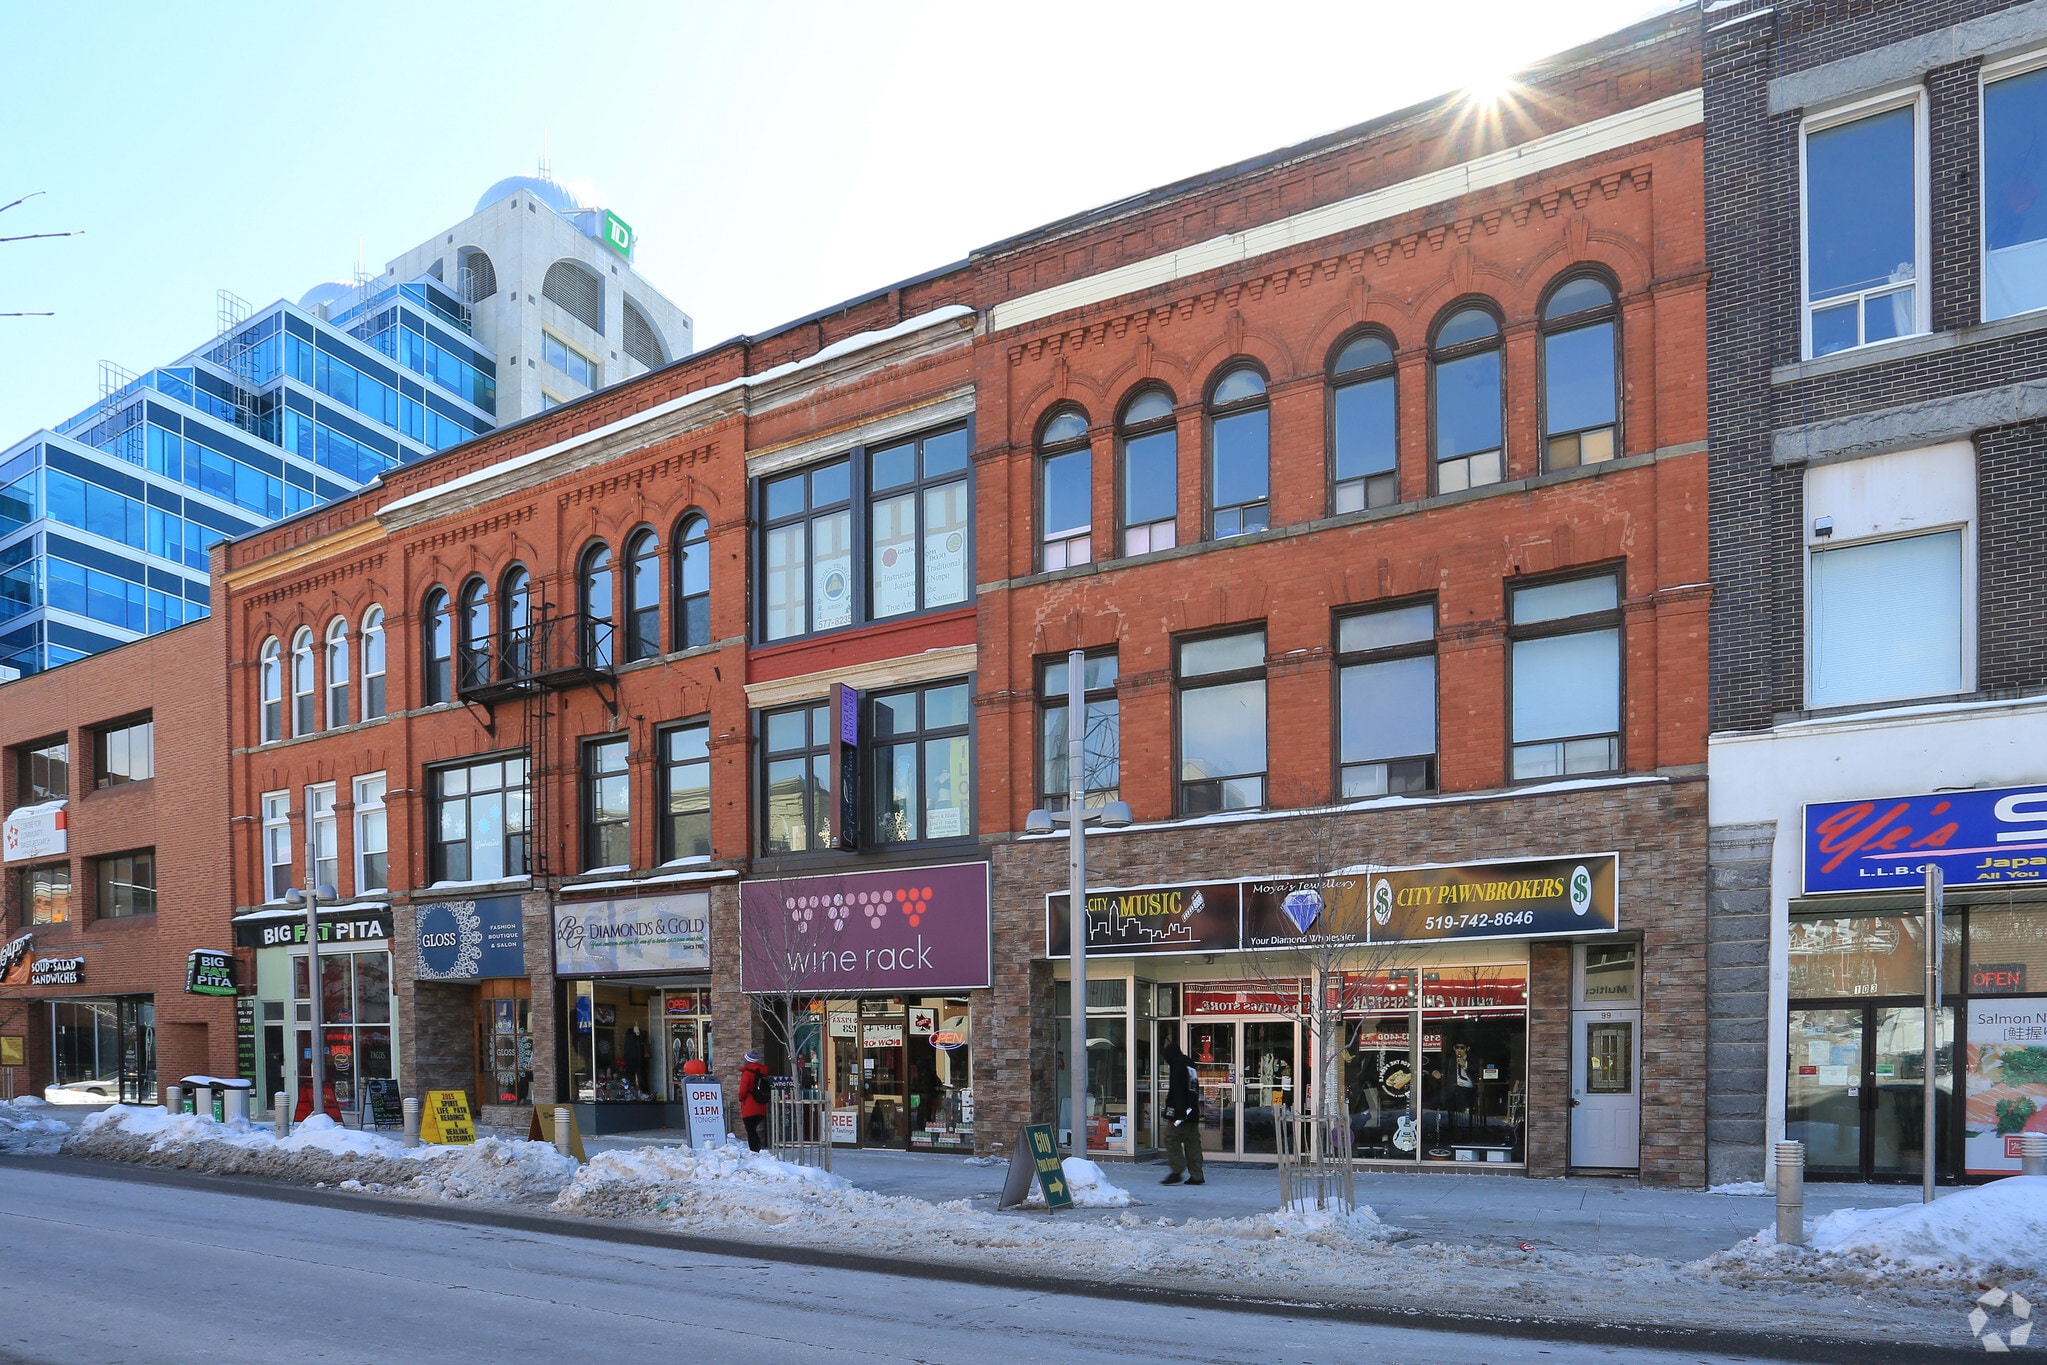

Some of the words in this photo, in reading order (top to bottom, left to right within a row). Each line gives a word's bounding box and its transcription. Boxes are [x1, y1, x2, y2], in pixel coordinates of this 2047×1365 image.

[607, 216, 629, 249] TD
[926, 558, 961, 572] Traditional
[1976, 872, 2000, 880] All
[2005, 870, 2040, 879] You
[1252, 883, 1296, 894] Moya's
[1298, 879, 1356, 892] Jewellery
[1397, 886, 1436, 907] CITY
[1437, 877, 1565, 905] PAWNBROKERS
[1087, 897, 1108, 912] CITY
[1118, 891, 1183, 917] MUSIC
[1425, 910, 1534, 931] 519-742-8646
[264, 925, 291, 945] BIG
[335, 920, 384, 940] PITA
[589, 921, 653, 939] DIAMONDS
[656, 919, 666, 935] &
[668, 917, 704, 933] GOLD
[422, 932, 456, 947] GLOSS
[488, 932, 519, 940] BOUTIQUE
[1250, 936, 1270, 945] Your
[1271, 935, 1308, 945] Diamond
[1309, 933, 1356, 944] Wholesaler
[787, 942, 857, 973] wine
[865, 934, 933, 971] rack
[201, 956, 225, 967] BIG
[200, 966, 230, 978] FAT
[31, 972, 77, 985] SANDWICHES
[197, 975, 233, 988] PITA
[1973, 971, 2020, 986] OPEN
[1854, 984, 1878, 994] 103
[667, 999, 690, 1011] OPEN
[1600, 1011, 1612, 1019] 99
[1978, 1013, 2031, 1025] Salmon
[930, 1032, 964, 1044] OPEN
[496, 1048, 516, 1056] GLOSS
[692, 1091, 718, 1101] OPEN
[694, 1106, 719, 1116] 11PM
[694, 1116, 719, 1124] TONIGHT
[829, 1115, 853, 1127] REE
[836, 1127, 855, 1135] Tastings
[446, 1135, 475, 1143] SESSIONS!
[1034, 1131, 1052, 1153] City
